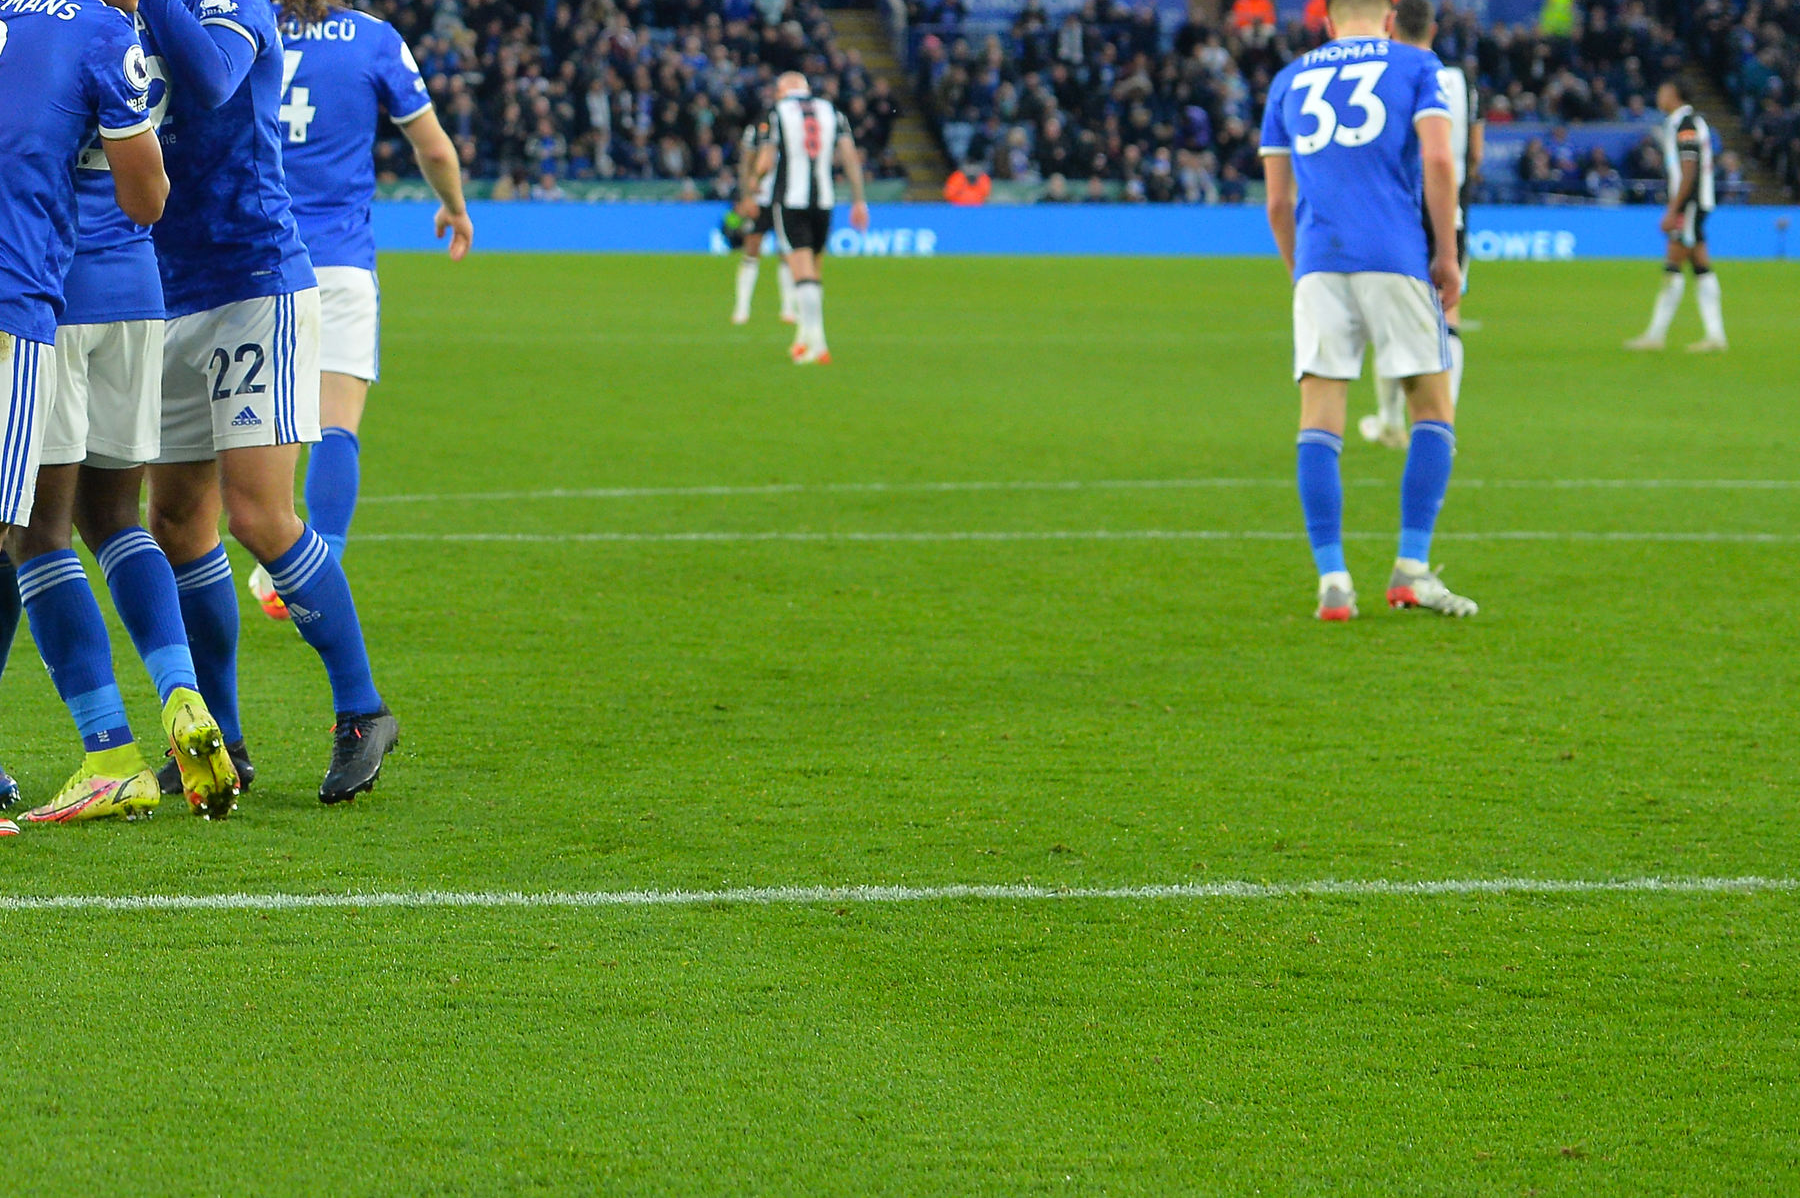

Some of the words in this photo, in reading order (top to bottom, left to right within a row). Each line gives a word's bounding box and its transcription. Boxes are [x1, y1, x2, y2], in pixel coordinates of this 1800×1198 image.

[1302, 41, 1389, 67] THOMAS
[279, 50, 316, 143] 4
[1291, 61, 1388, 156] 33
[804, 115, 821, 159] 8
[830, 228, 937, 256] OWER
[1468, 230, 1577, 261] OWER
[209, 343, 266, 402] 22
